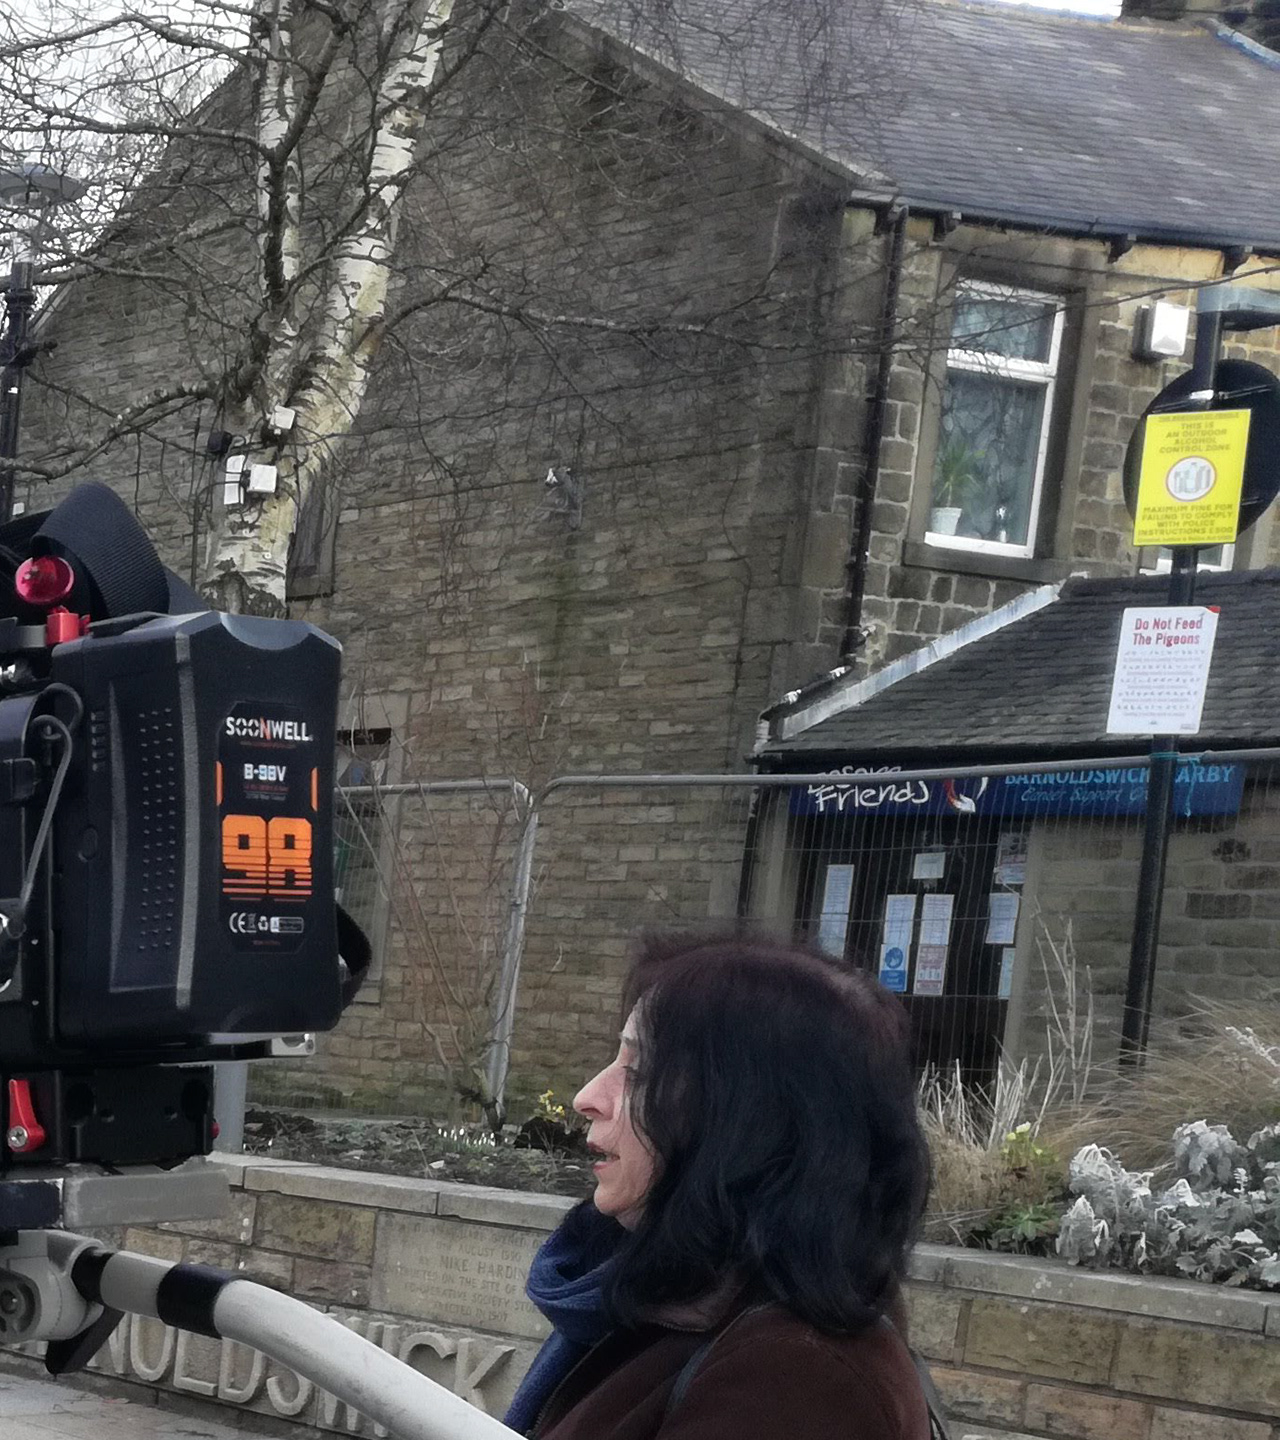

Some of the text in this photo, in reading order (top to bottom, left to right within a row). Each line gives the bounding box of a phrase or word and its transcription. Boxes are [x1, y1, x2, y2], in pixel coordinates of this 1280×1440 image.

[1134, 616, 1203, 630] Do Not Feed
[1133, 633, 1200, 647] The Pigeons
[225, 716, 310, 741] SOONWELL
[1175, 764, 1235, 783] ARBY
[815, 780, 929, 812] Friends
[1070, 786, 1122, 806] Support
[222, 814, 312, 902] 98
[440, 1255, 469, 1273] MIKE
[478, 1261, 528, 1280] HARDIN
[514, 1299, 538, 1314] STOR
